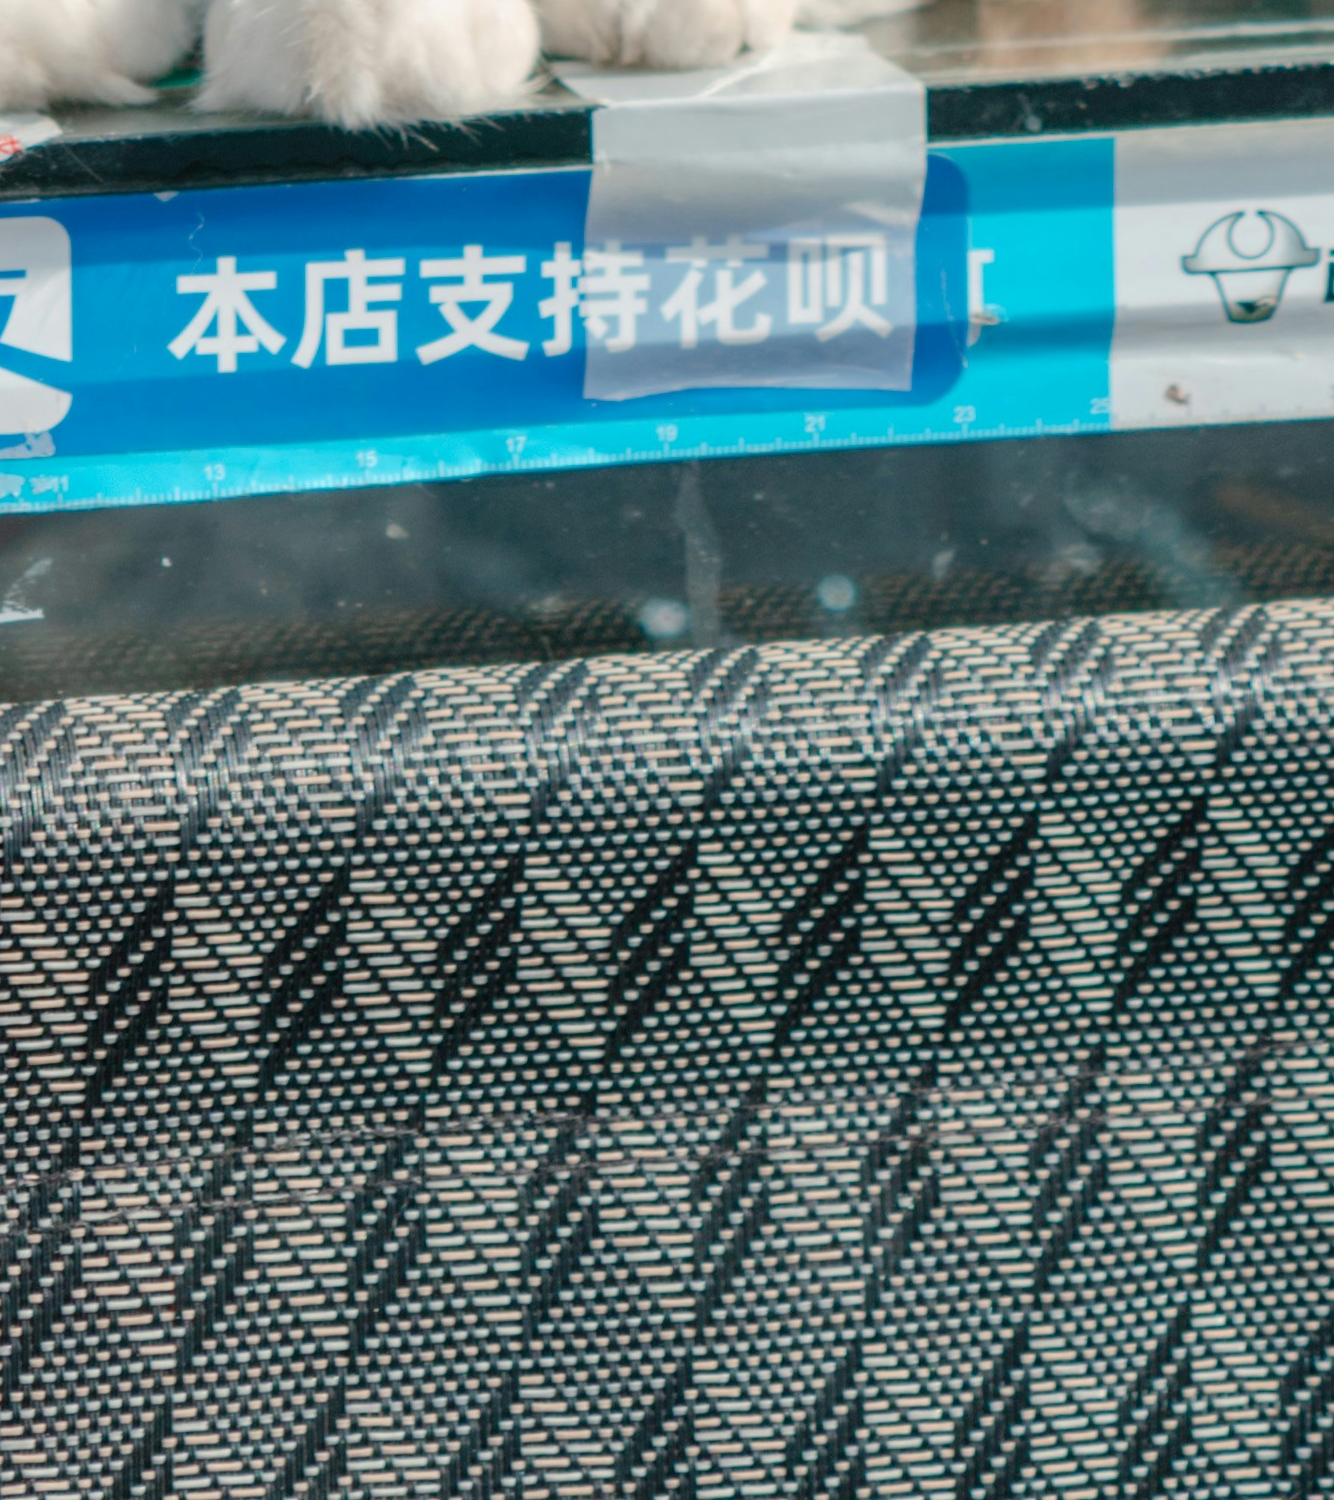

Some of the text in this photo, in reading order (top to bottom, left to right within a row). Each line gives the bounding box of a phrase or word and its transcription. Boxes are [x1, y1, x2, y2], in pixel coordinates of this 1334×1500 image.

[167, 232, 893, 373] 本店支持花呗
[204, 463, 226, 481] 13
[356, 450, 378, 468] 15
[506, 436, 527, 453] 17
[656, 424, 679, 442] 19
[804, 415, 826, 432] 21
[953, 406, 976, 424] 23
